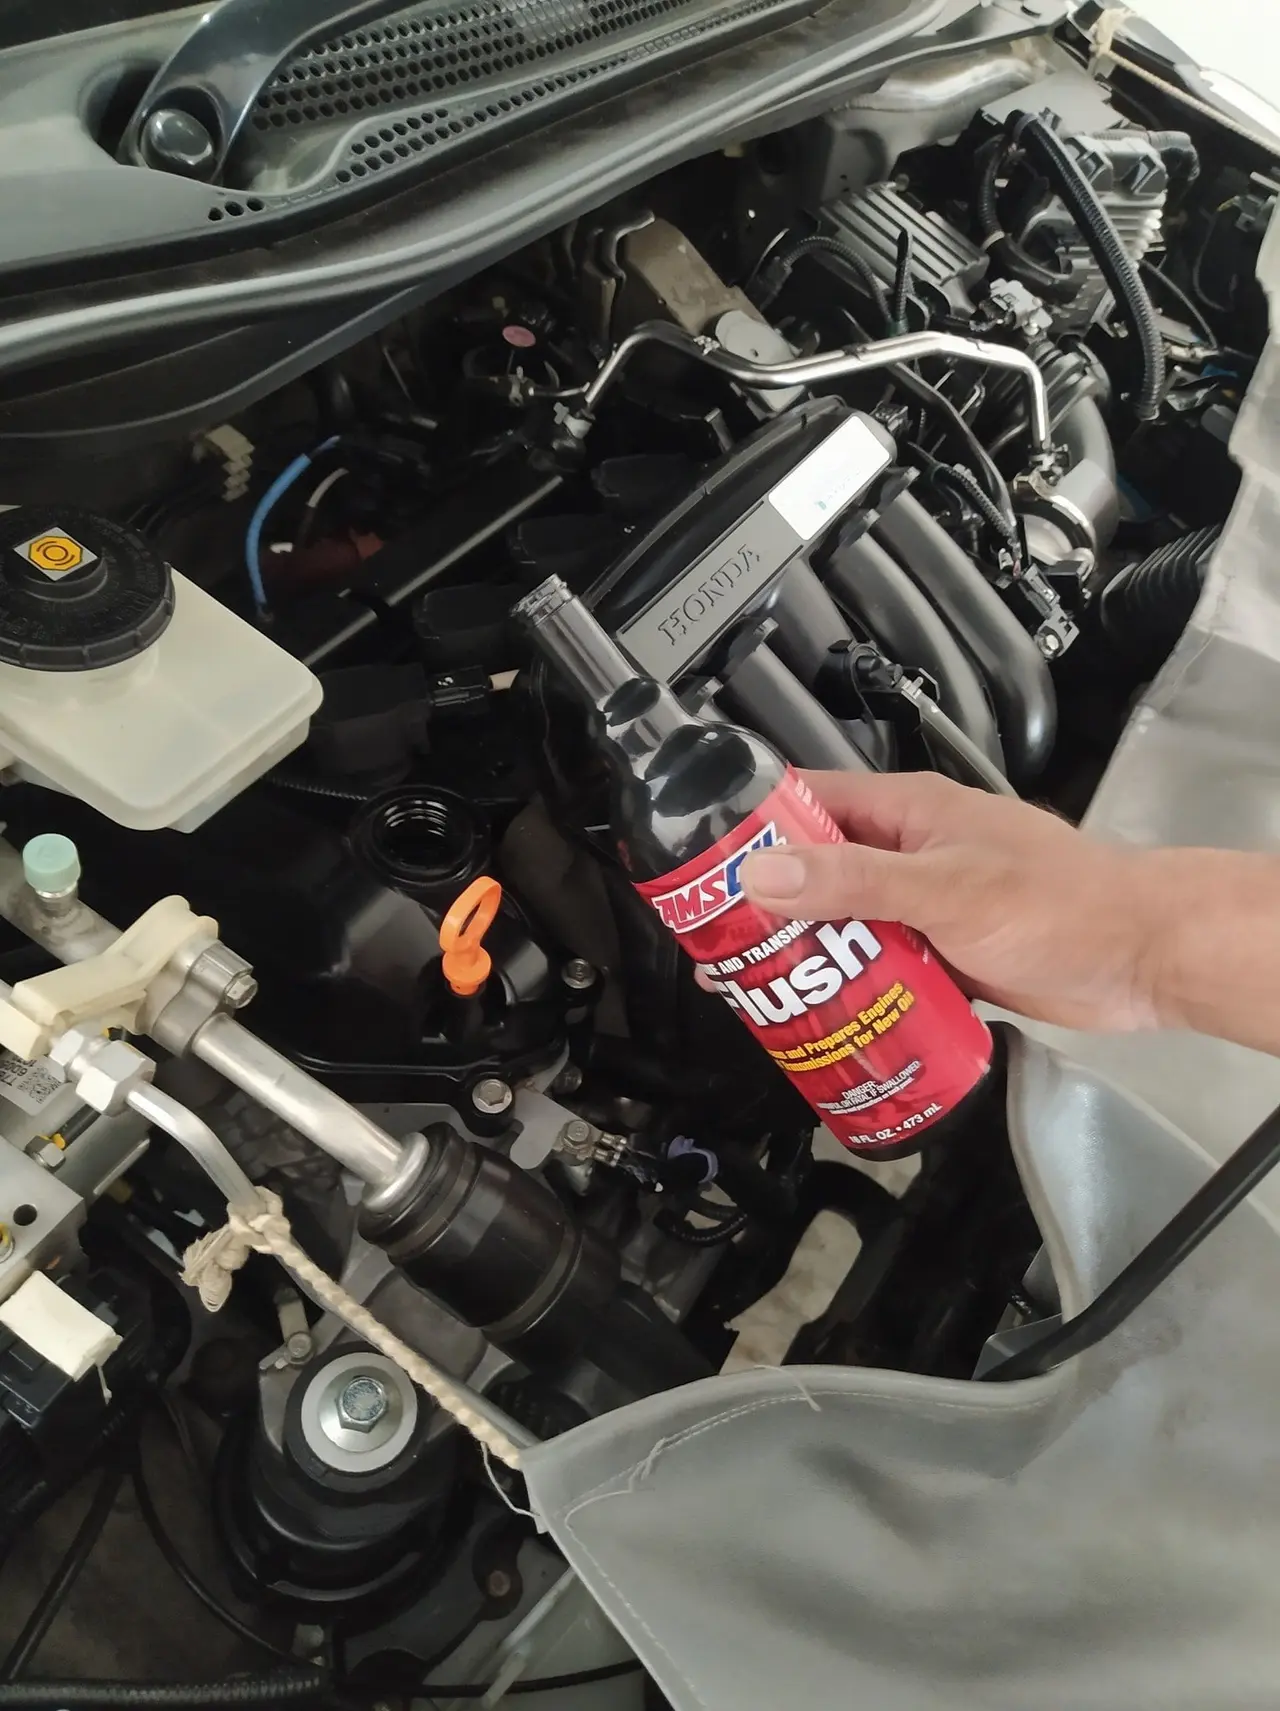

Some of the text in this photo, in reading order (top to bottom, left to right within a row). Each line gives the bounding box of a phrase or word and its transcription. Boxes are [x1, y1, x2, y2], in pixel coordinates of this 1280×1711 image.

[657, 543, 761, 646] HONDA
[718, 956, 745, 975] AND
[742, 920, 816, 964] TRANSMI
[803, 1021, 861, 1055] Prepares
[857, 982, 904, 1026] Engines
[853, 1029, 875, 1048] for
[871, 1008, 901, 1035] New
[896, 991, 915, 1012] Oil
[850, 1093, 871, 1106] FATAL
[870, 1088, 879, 1098] IF
[903, 1113, 924, 1130] 473
[923, 1102, 943, 1118] mL
